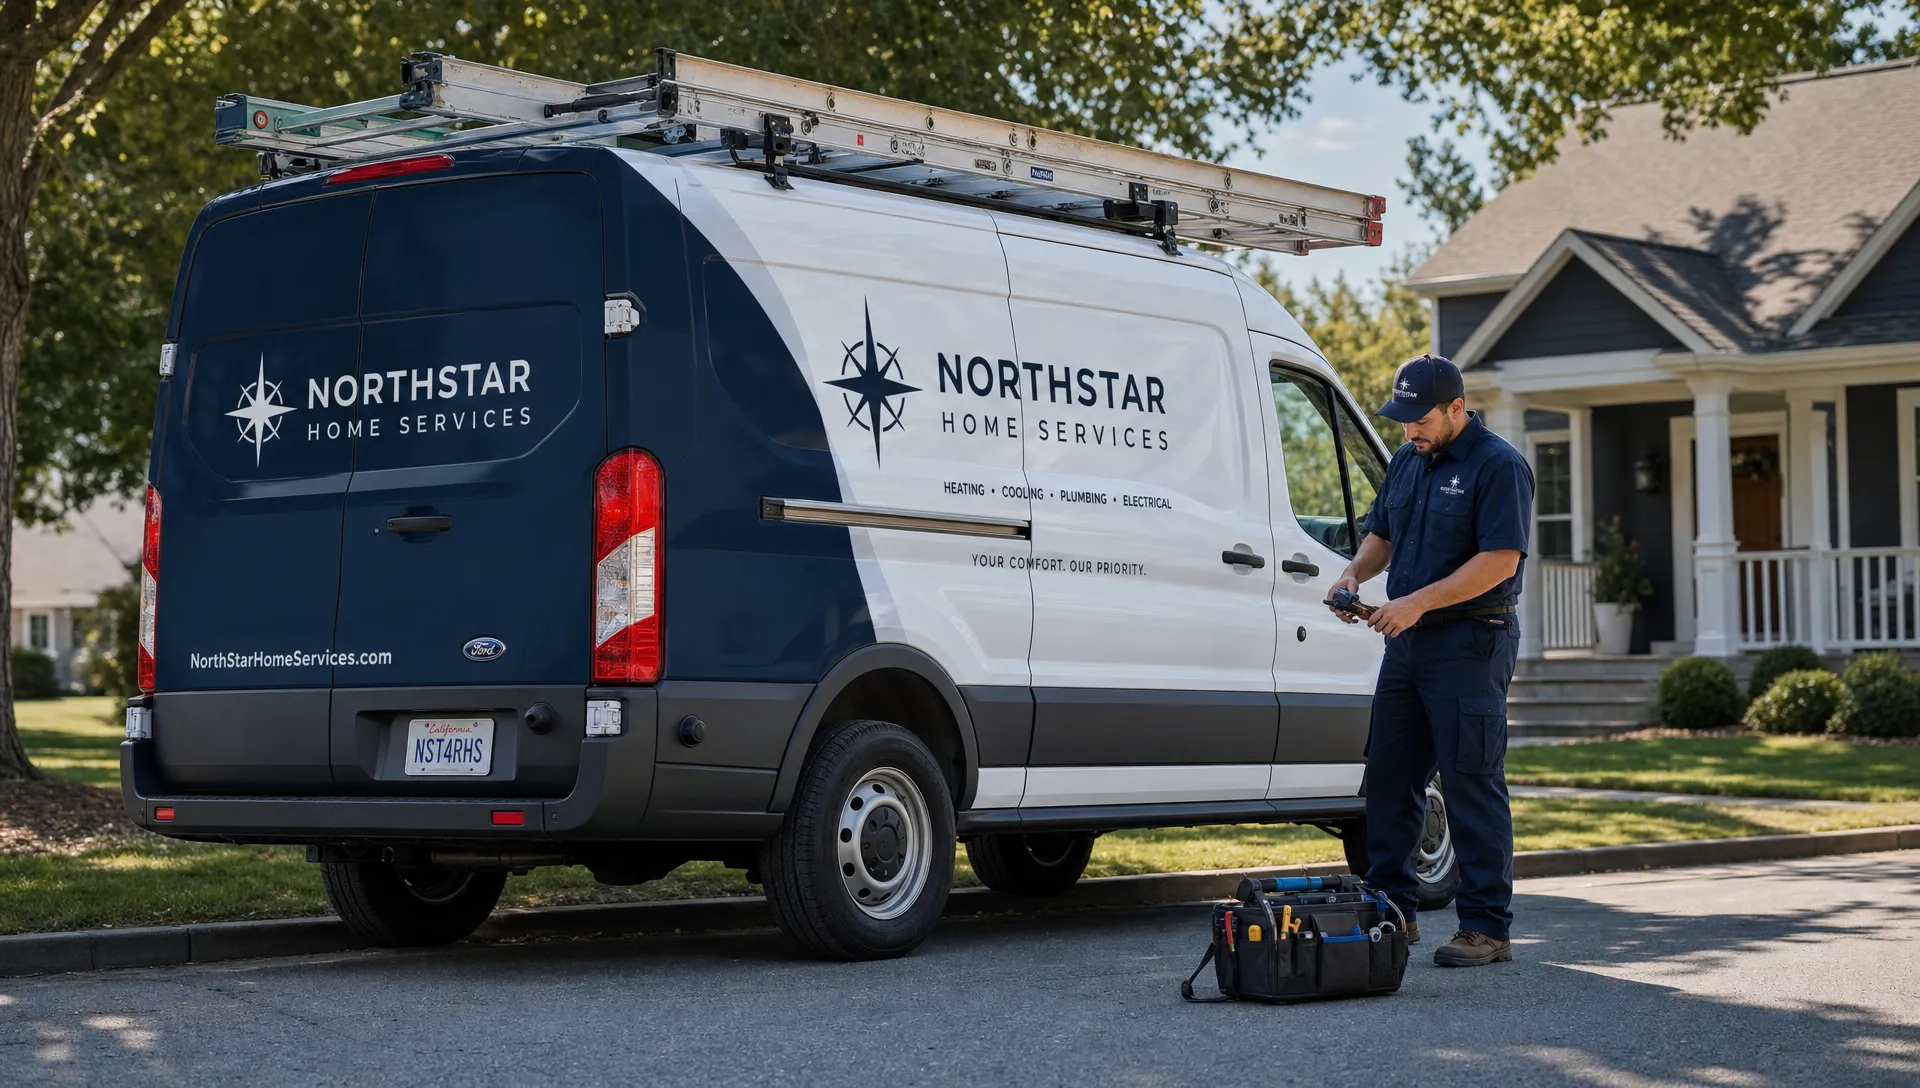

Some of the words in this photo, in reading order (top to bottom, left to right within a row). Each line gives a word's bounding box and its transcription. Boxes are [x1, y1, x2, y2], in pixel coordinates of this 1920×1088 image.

[308, 359, 531, 410] NORTHSTAR
[937, 352, 1166, 415] NORTHSTAR
[307, 418, 381, 441] HOME
[399, 406, 532, 435] SERVICES
[941, 411, 1018, 439] HOME
[1038, 420, 1169, 451] SERVICES
[944, 481, 985, 496] HEATING
[1002, 485, 1044, 500] COOLING
[1060, 489, 1107, 505] PLUMBING
[1122, 494, 1172, 510] ELECTRICAL
[971, 553, 1004, 569] YOUR
[1009, 556, 1066, 572] COMFORT.
[1069, 560, 1092, 574] OUR
[1096, 561, 1147, 577] PRIORITY.
[190, 648, 392, 669] NorthStarHomeServices.com
[429, 723, 473, 736] California
[414, 737, 484, 764] NST4RHS
